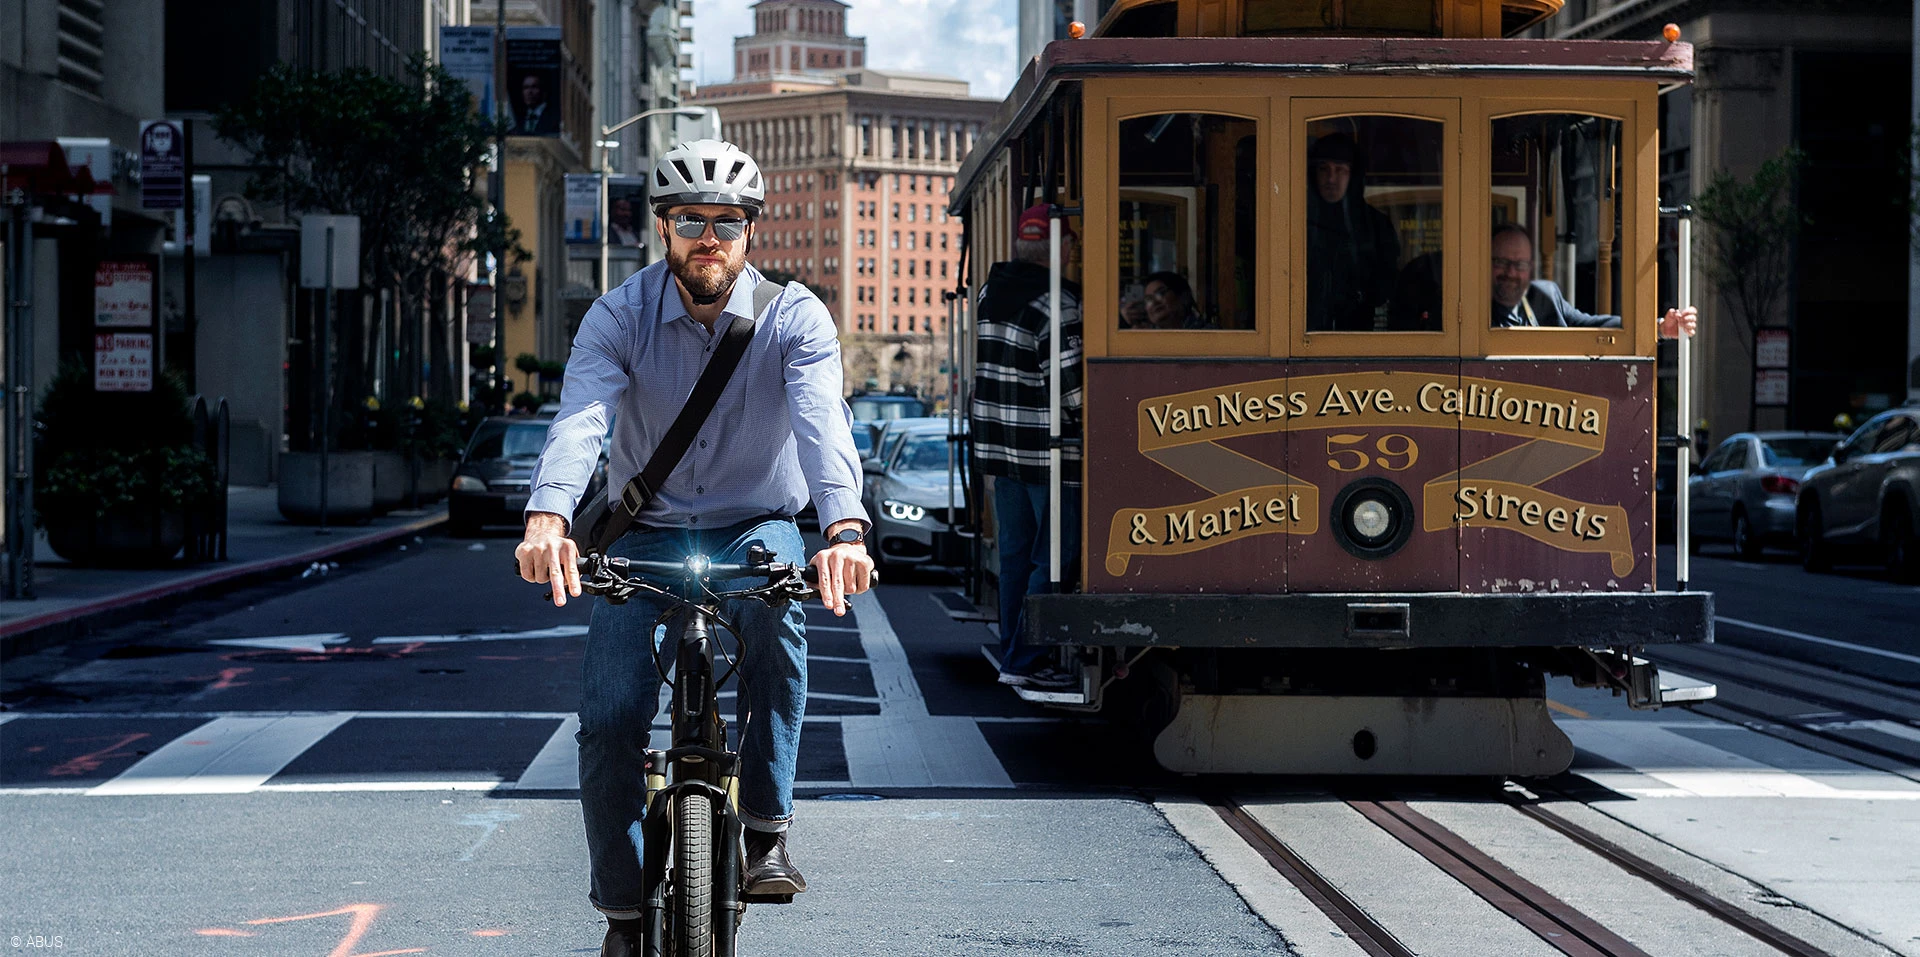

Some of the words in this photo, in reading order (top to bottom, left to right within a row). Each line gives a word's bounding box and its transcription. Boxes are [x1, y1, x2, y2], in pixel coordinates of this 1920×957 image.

[115, 338, 151, 349] PARKING
[1146, 402, 1213, 438] Van
[1215, 391, 1308, 427] Ness
[1417, 382, 1601, 435] California
[1326, 433, 1419, 472] 59
[1128, 511, 1158, 548] &
[1163, 492, 1302, 545] Market
[1453, 485, 1609, 541] Streets
